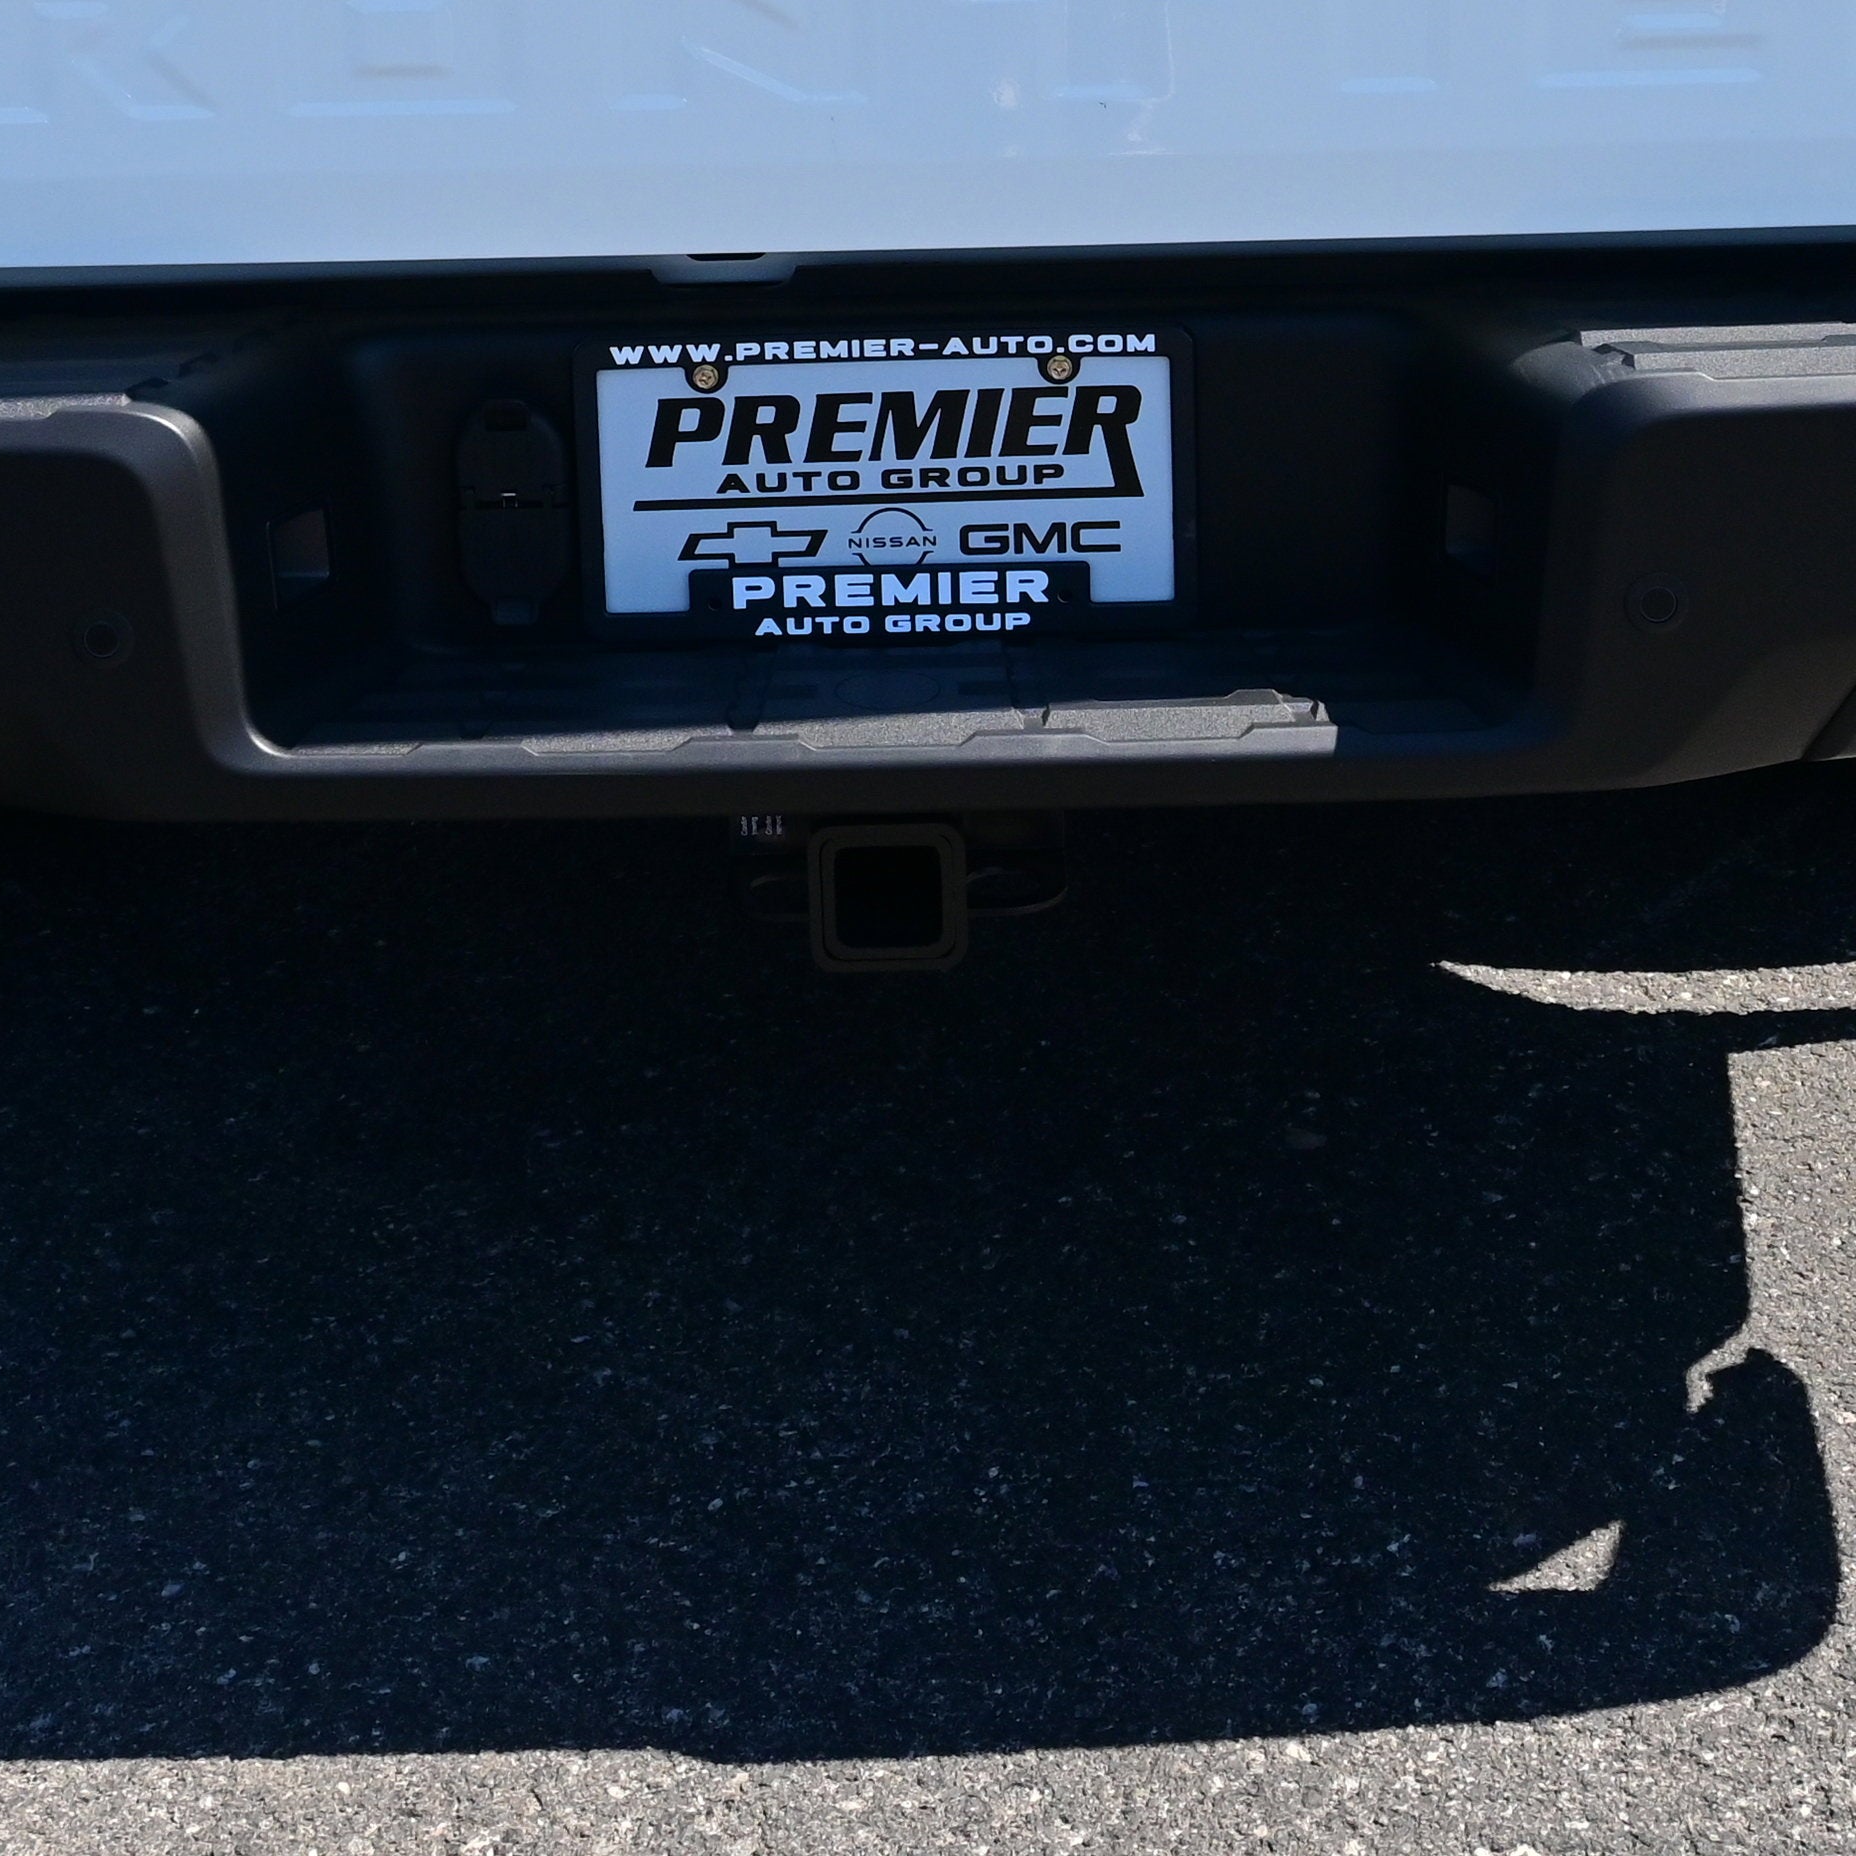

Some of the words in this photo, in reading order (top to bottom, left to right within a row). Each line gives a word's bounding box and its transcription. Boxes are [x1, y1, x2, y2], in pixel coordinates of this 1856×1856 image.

[609, 333, 1156, 366] WWW.PREMIER-AUTO.COM
[644, 384, 1146, 498] PREMIER
[715, 469, 861, 495] AUTO
[880, 463, 1066, 490] GROUP
[848, 533, 937, 550] NISSAN
[959, 520, 1122, 556] GMC
[732, 569, 1050, 610] PREMIER
[754, 615, 870, 636] AUTO
[884, 611, 1032, 633] GROUP
